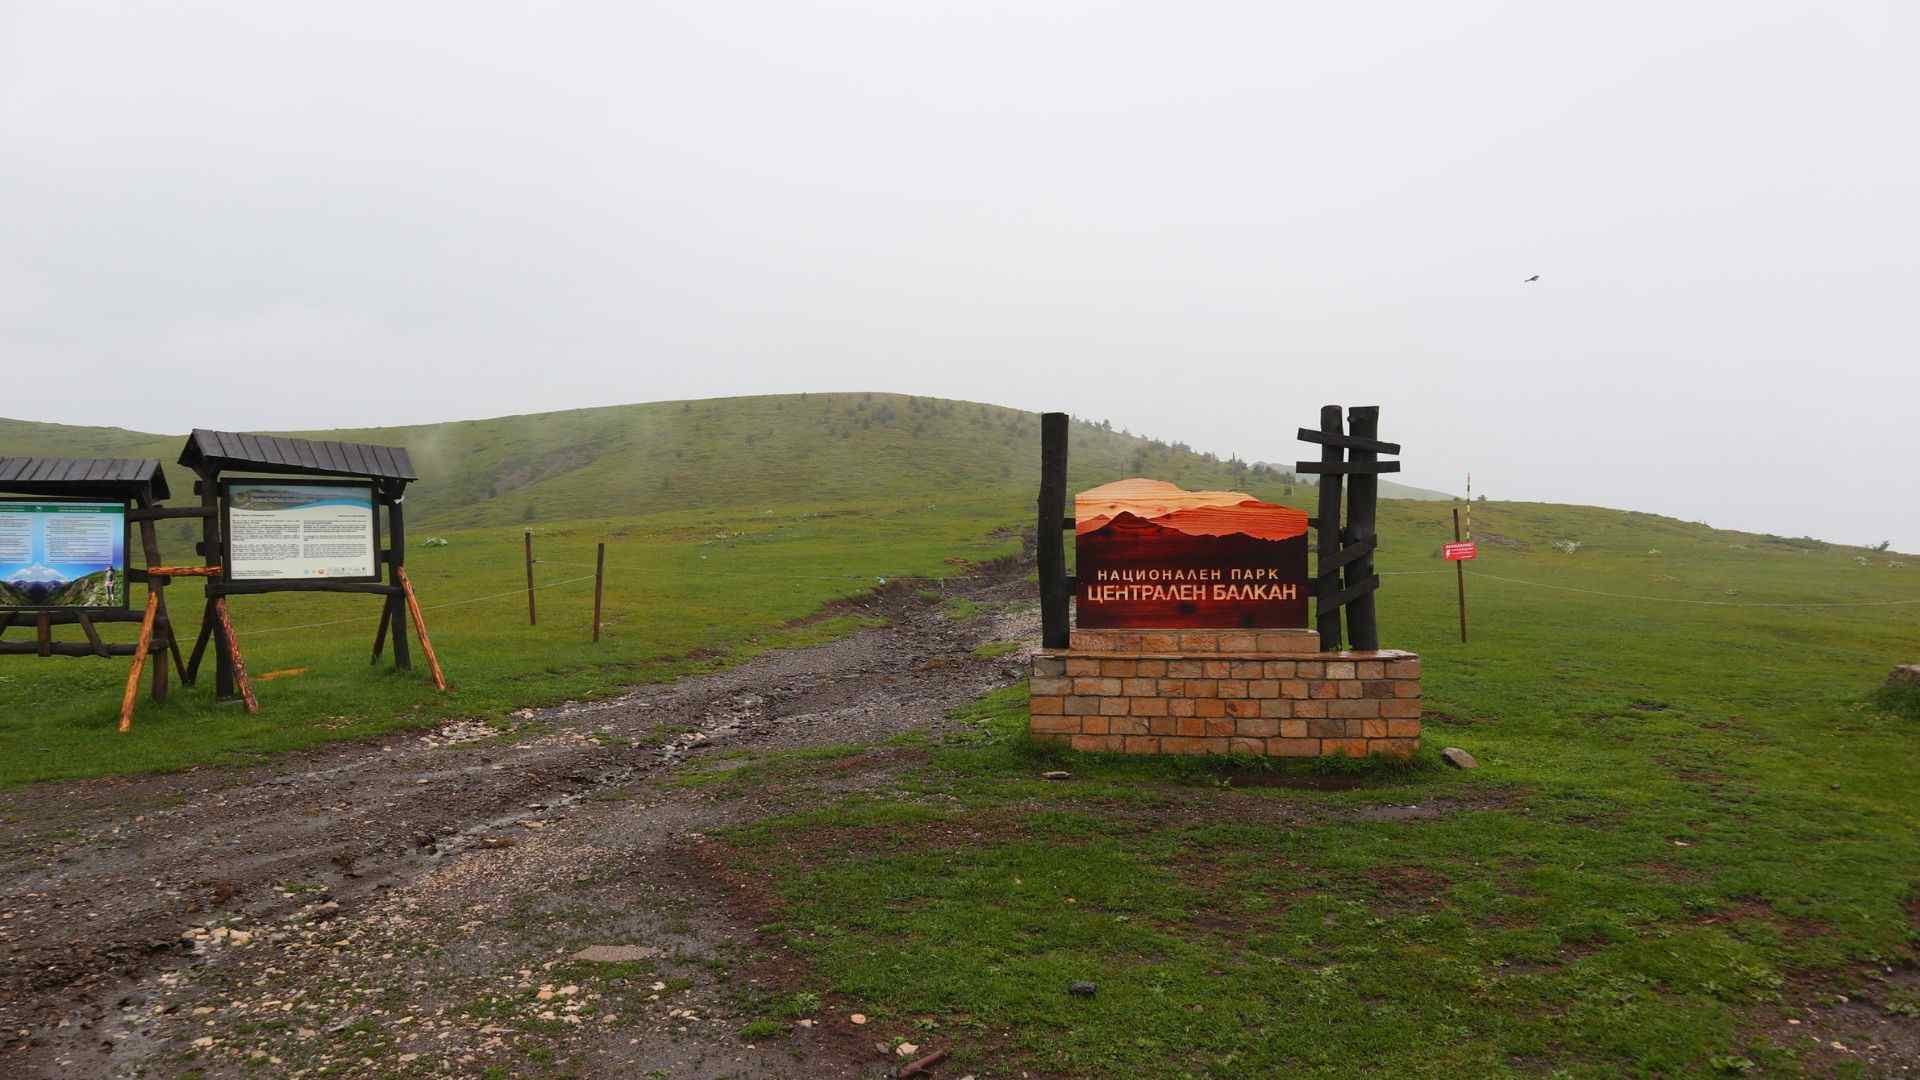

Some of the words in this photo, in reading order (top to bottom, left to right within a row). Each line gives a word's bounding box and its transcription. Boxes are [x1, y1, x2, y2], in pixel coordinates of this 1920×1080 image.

[1097, 569, 1221, 582] НАЦИОНАЛЕН
[1231, 569, 1279, 581] ПАРК
[1087, 585, 1207, 603] ЦЕНТРАЛЕН
[1213, 584, 1297, 600] БАЛКАН
